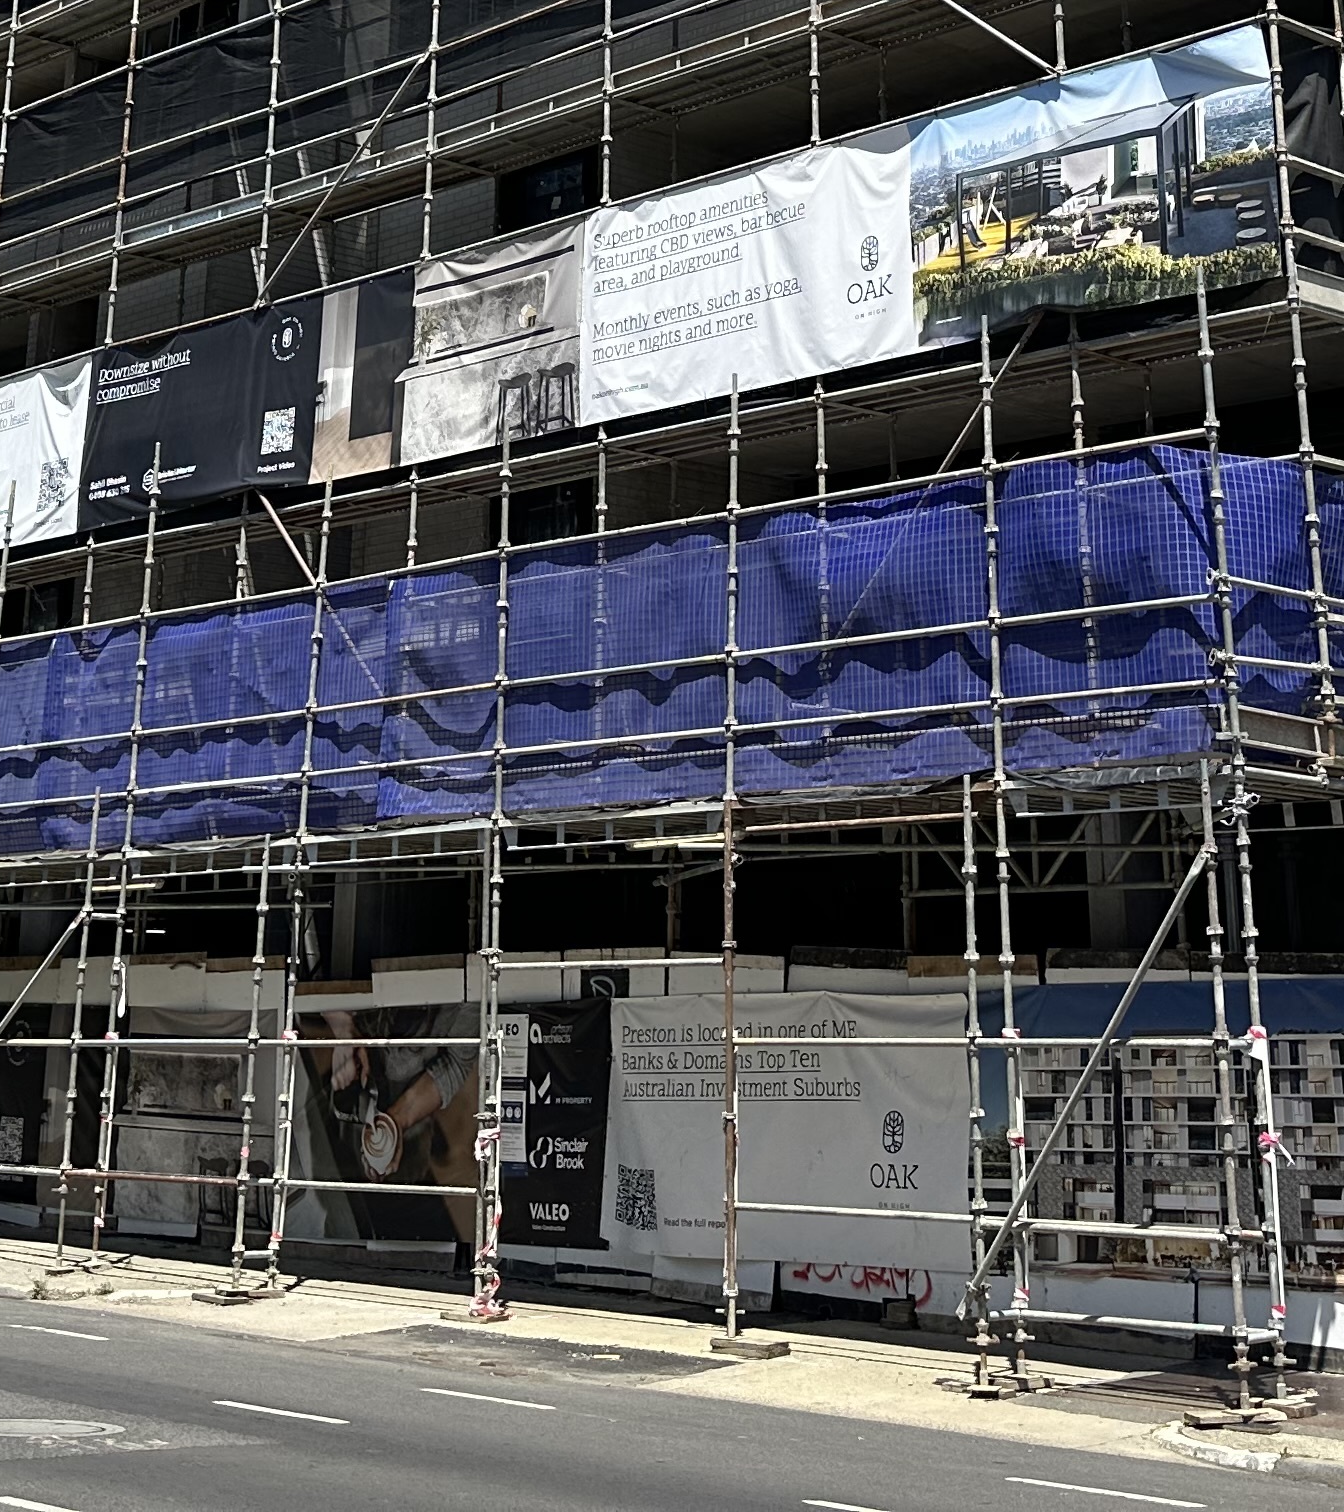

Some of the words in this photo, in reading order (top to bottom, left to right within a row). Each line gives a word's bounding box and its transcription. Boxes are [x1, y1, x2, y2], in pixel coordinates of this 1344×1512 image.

[593, 224, 644, 249] Superb
[647, 211, 696, 236] rooftop
[699, 191, 769, 221] amenities
[593, 244, 657, 272] featuring
[660, 235, 689, 254] CBD
[692, 222, 737, 246] views,
[593, 276, 627, 294] area,
[631, 264, 656, 285] and
[847, 273, 893, 304] OAK
[593, 312, 650, 339] Monthly
[654, 301, 703, 324] events,
[706, 290, 740, 312] such
[744, 286, 761, 301] as
[765, 277, 803, 300] yoga,
[592, 341, 635, 362] movie
[638, 329, 682, 352] nights
[685, 321, 712, 340] and
[716, 312, 758, 333] more.
[98, 360, 150, 382] Downsize
[151, 348, 191, 371] without
[96, 376, 161, 402] compromise
[0, 417, 8, 429] to
[9, 411, 31, 427] lease
[256, 463, 278, 474] Project
[278, 461, 296, 471] Video
[622, 1025, 677, 1044] Preston
[681, 1024, 693, 1042] is
[697, 1022, 753, 1042] locaed
[758, 1021, 773, 1039] in
[778, 1023, 806, 1039] one
[810, 1019, 828, 1039] of
[831, 1019, 857, 1039] ME
[622, 1052, 664, 1071] Banks
[667, 1051, 679, 1070] &
[683, 1051, 753, 1070] Domans
[758, 1050, 786, 1071] Top
[790, 1049, 821, 1068] Ten
[623, 1078, 695, 1097] Australian
[699, 1078, 789, 1098] Invstment
[793, 1077, 861, 1097] Suburbs
[554, 1136, 589, 1153] Sinclair
[556, 1153, 585, 1170] Brook
[869, 1162, 919, 1190] OAK
[529, 1202, 570, 1221] VALEO
[663, 1217, 680, 1228] Read
[680, 1217, 693, 1228] the
[693, 1218, 707, 1229] full
[707, 1219, 727, 1230] repo
